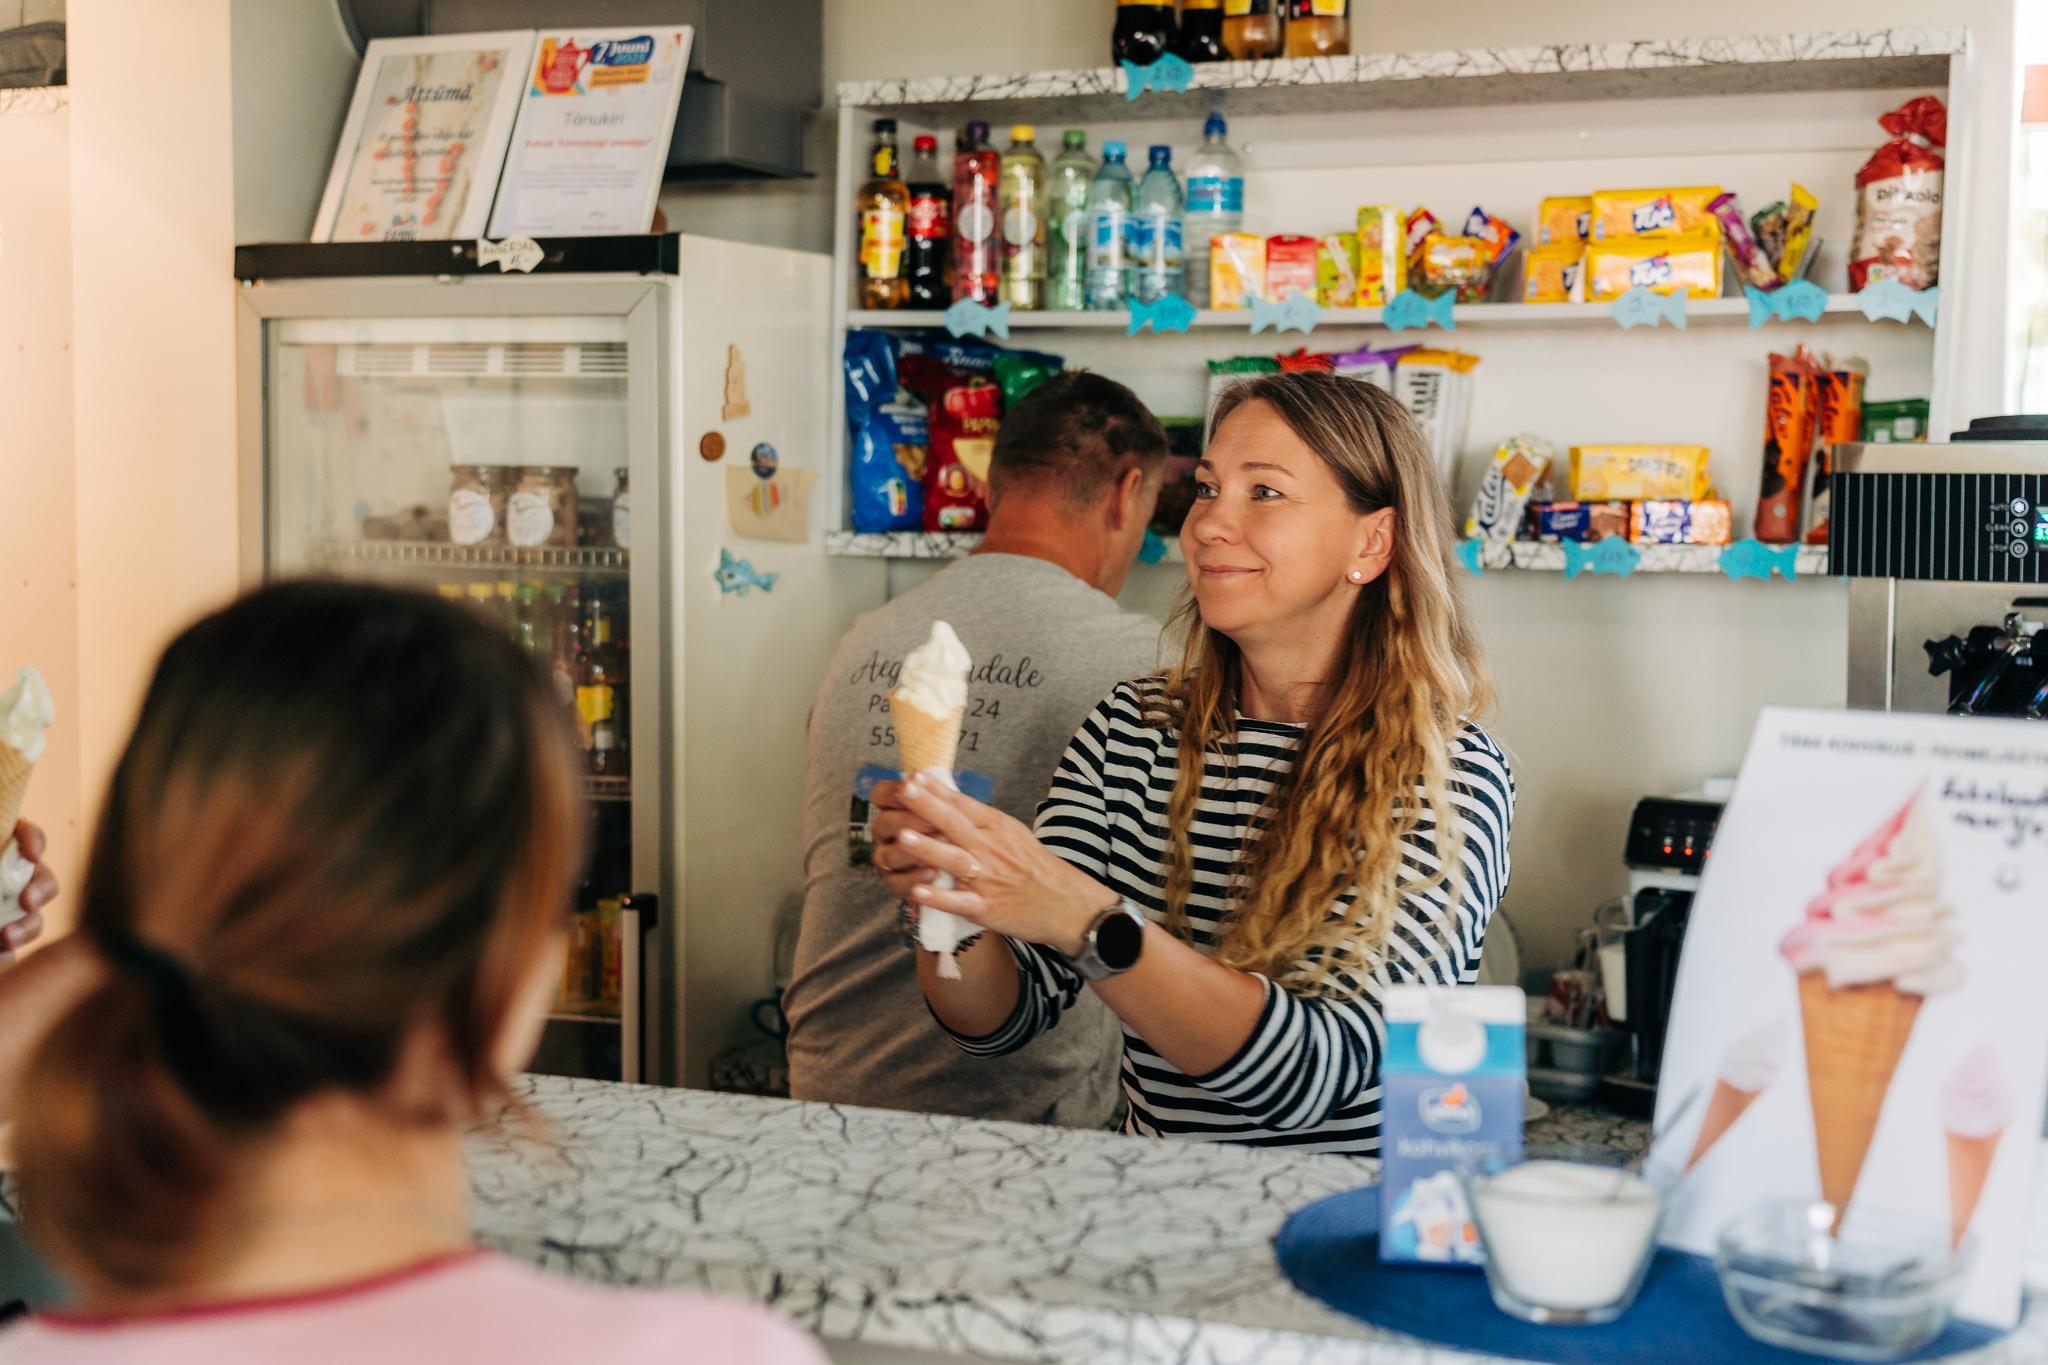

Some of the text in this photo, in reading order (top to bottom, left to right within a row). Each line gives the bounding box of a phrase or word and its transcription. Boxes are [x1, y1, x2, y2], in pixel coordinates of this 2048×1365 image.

[1633, 202, 1674, 231] TUC
[1630, 259, 1672, 287] TUC
[1984, 523, 2010, 532] CLEAN
[851, 650, 1044, 689] Aeg ndale
[970, 698, 1000, 719] 24
